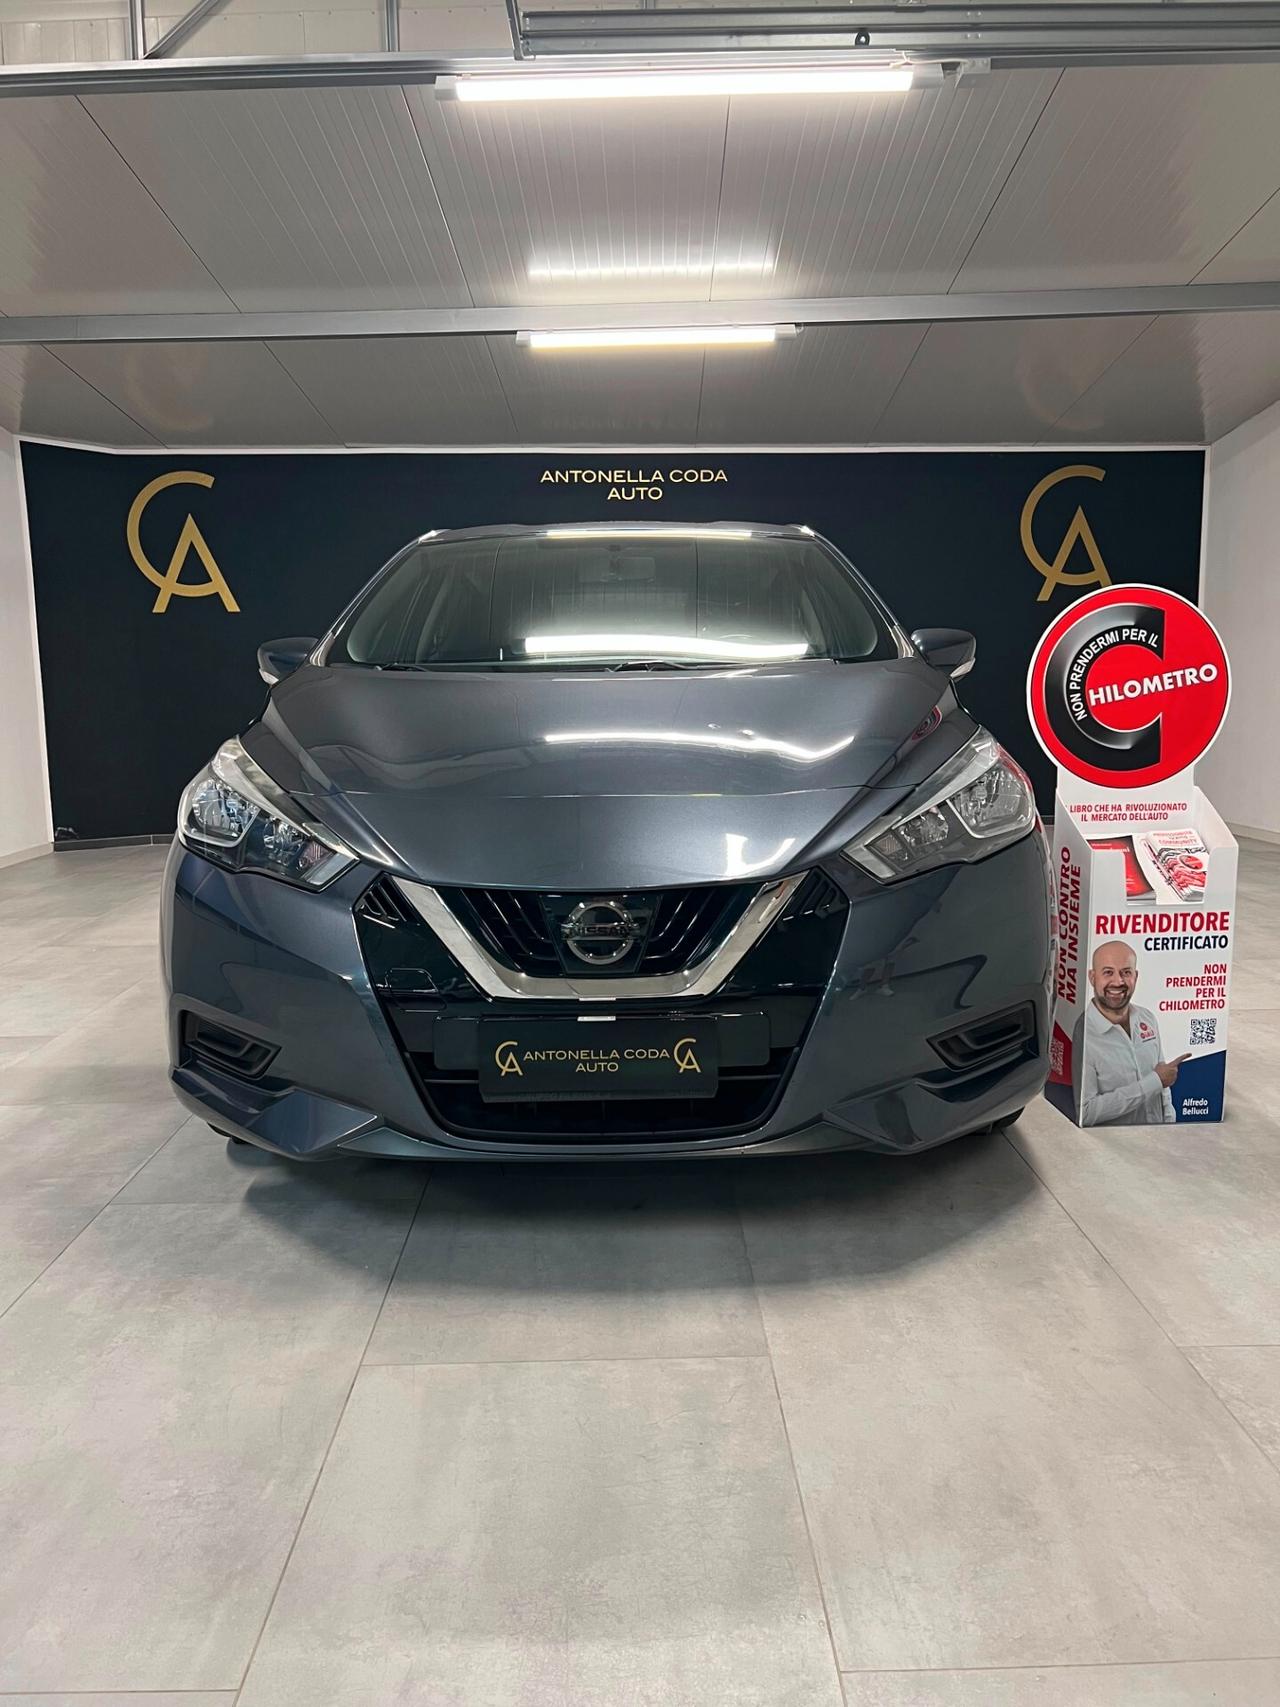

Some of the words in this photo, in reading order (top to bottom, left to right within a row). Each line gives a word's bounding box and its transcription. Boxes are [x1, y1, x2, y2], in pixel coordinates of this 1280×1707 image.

[540, 470, 665, 483] ANTONELLA
[669, 469, 729, 483] CODA
[607, 486, 663, 500] AUTO
[1122, 628, 1147, 642] PER
[1148, 633, 1159, 648] IL
[1069, 630, 1120, 690] PRENDERMI
[1069, 694, 1088, 721] NON
[1069, 804, 1093, 813] LIBRO
[1094, 804, 1109, 812] CHE
[1111, 804, 1122, 812] HA
[1125, 802, 1188, 812] RIVOLUZIONATO
[1080, 814, 1088, 822] IL
[1091, 813, 1127, 822] MERCATO
[1129, 812, 1169, 821] DELL'AUTO
[1058, 846, 1071, 940] CONTRO
[1067, 864, 1081, 962] INSIEME
[1095, 911, 1230, 935] RIVENDITORE
[1144, 935, 1229, 951] CERTIFICATO
[1057, 946, 1068, 998] NON
[1204, 963, 1227, 975] NON
[1065, 967, 1077, 1005] MA
[1166, 975, 1227, 988] PRENDERMI
[1196, 988, 1214, 998] PER
[1217, 987, 1226, 997] IL
[1159, 999, 1225, 1012] CHILOMETRO
[523, 1050, 620, 1061] ANTONELLA
[624, 1048, 670, 1060] CODA
[575, 1062, 619, 1073] AUTO
[1183, 1098, 1208, 1107] Alfredo
[1182, 1107, 1209, 1115] Bellucci
